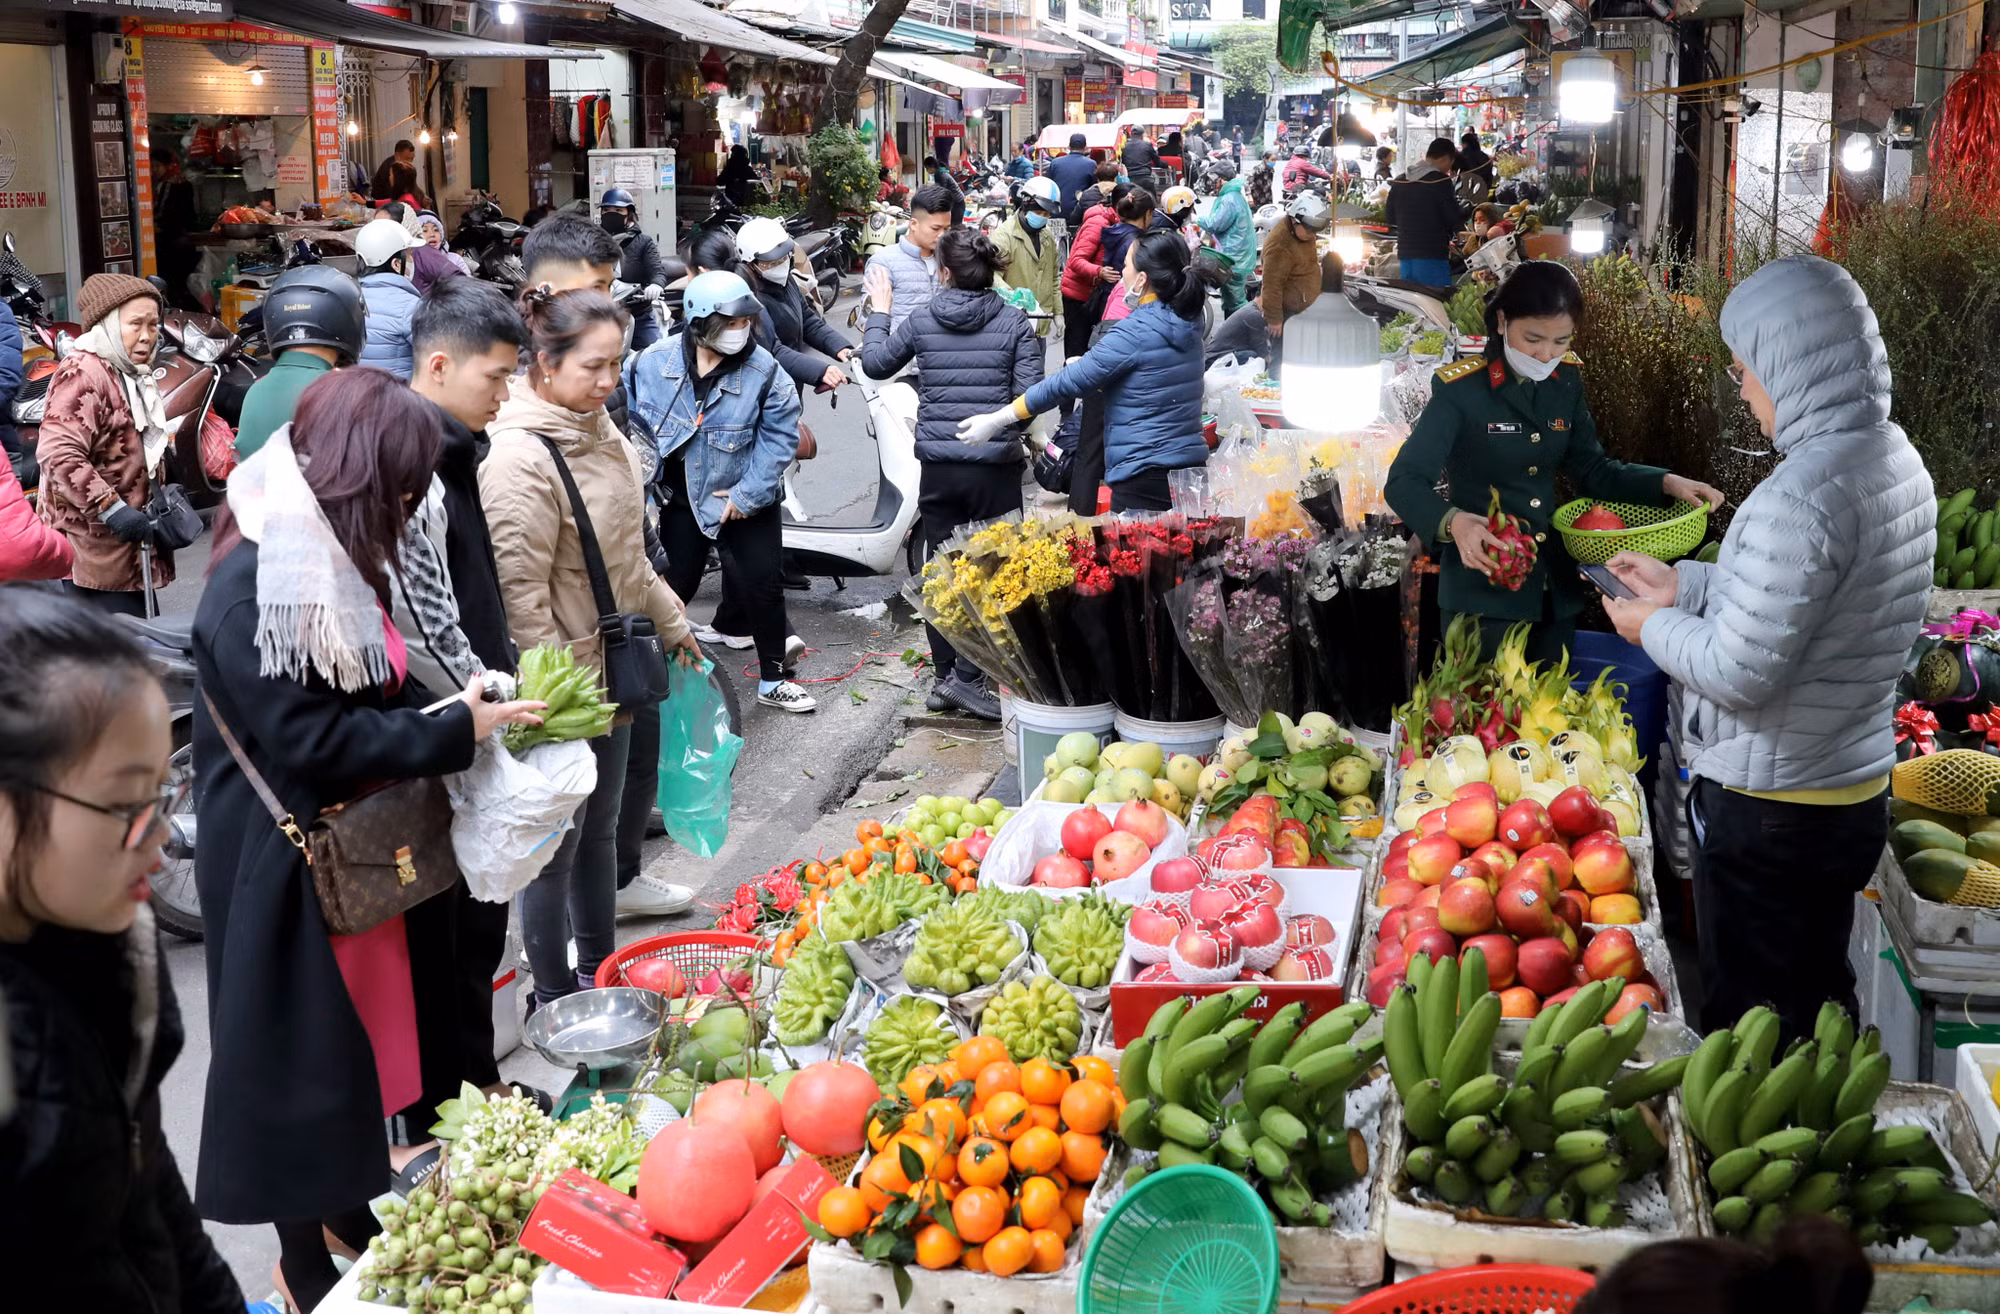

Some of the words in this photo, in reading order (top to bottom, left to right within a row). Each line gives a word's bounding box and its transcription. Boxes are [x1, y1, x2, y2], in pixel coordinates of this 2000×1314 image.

[125, 40, 132, 55] 8
[321, 52, 326, 65] 8
[537, 1219, 567, 1237] Fresh
[564, 1234, 603, 1258] Cherries
[698, 1283, 718, 1304] Fresh
[717, 1258, 746, 1288] Cherries
